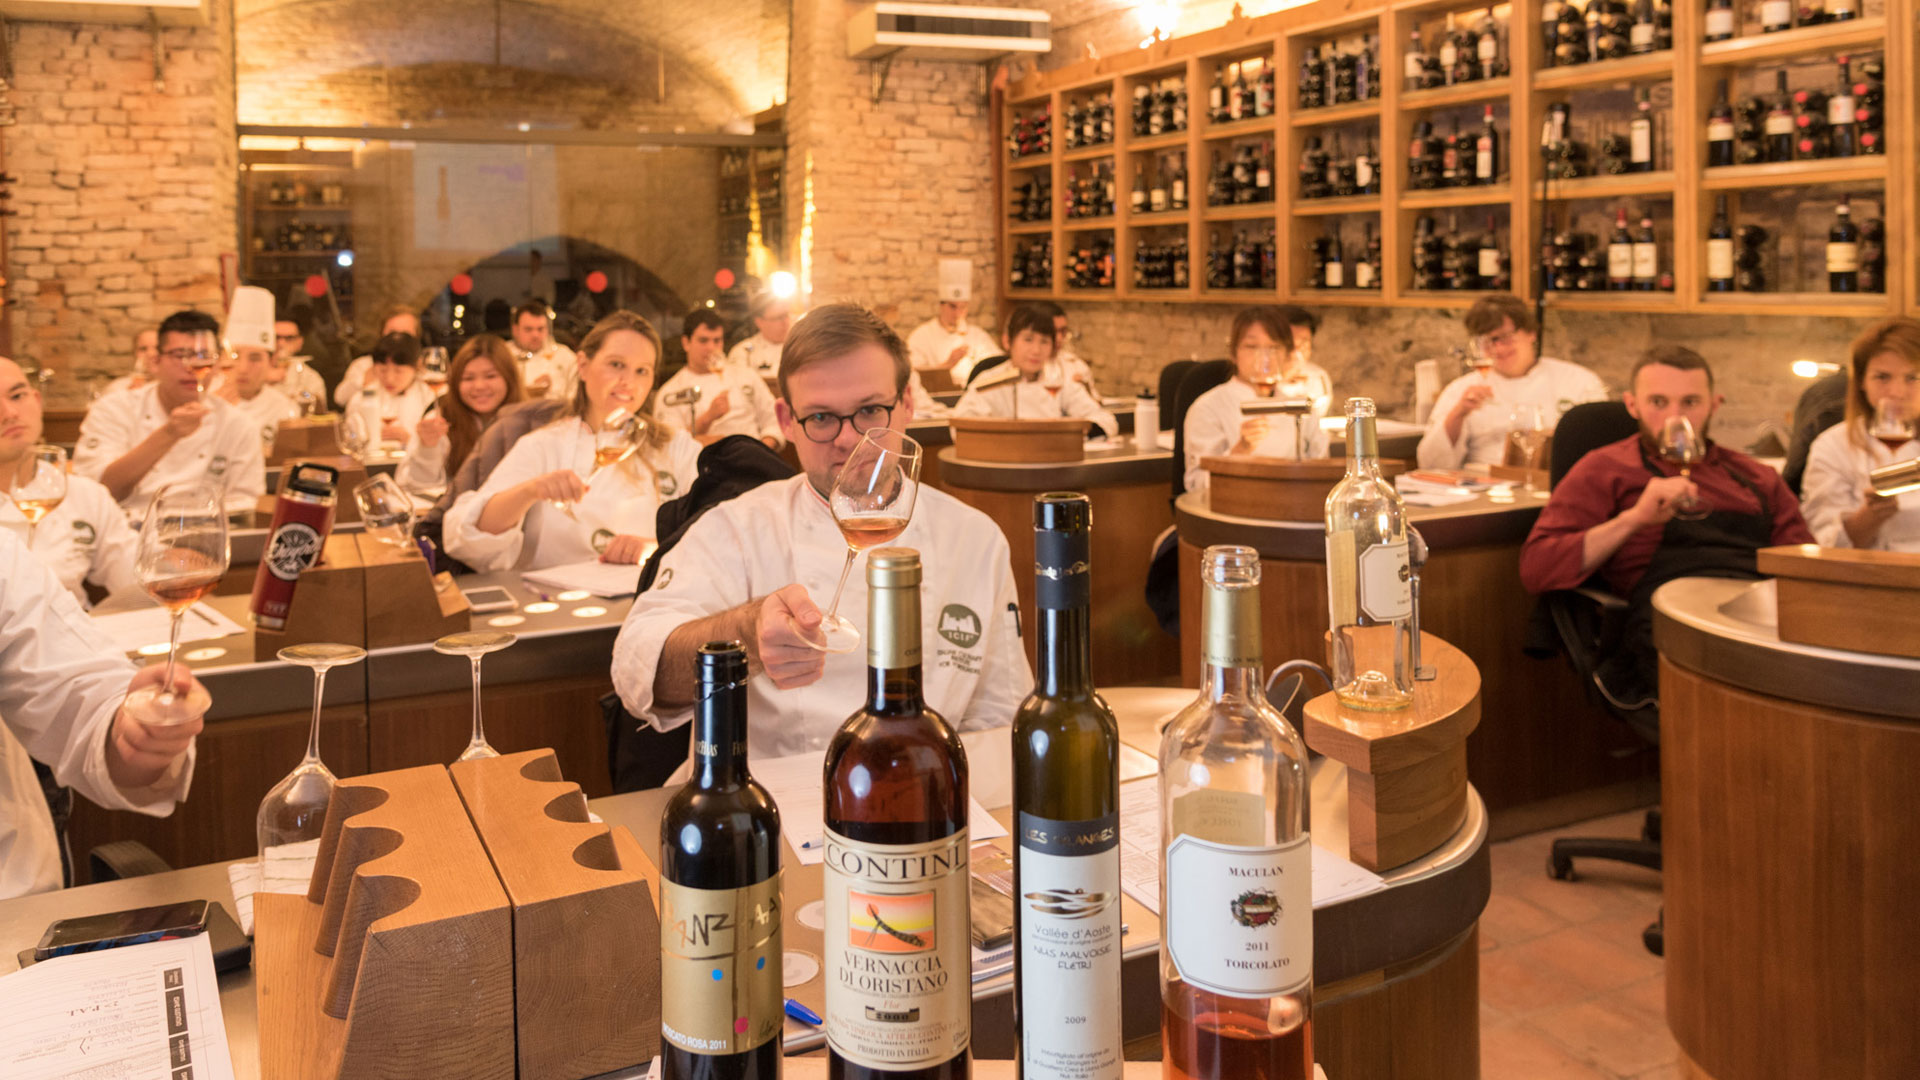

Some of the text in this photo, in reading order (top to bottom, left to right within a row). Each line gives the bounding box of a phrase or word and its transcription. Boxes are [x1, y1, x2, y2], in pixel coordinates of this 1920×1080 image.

[827, 843, 961, 879] CONTINI
[1228, 866, 1284, 878] MACULAN
[1034, 922, 1069, 939] Vallée
[1245, 942, 1269, 952] 2011
[844, 951, 943, 975] VERNACCIA
[1224, 958, 1290, 970] TORCOLATO
[839, 966, 854, 986] DI
[859, 970, 949, 994] ORISTANO
[1065, 1016, 1087, 1025] 2009
[687, 1036, 709, 1050] ROSA
[709, 1039, 727, 1051] 2011
